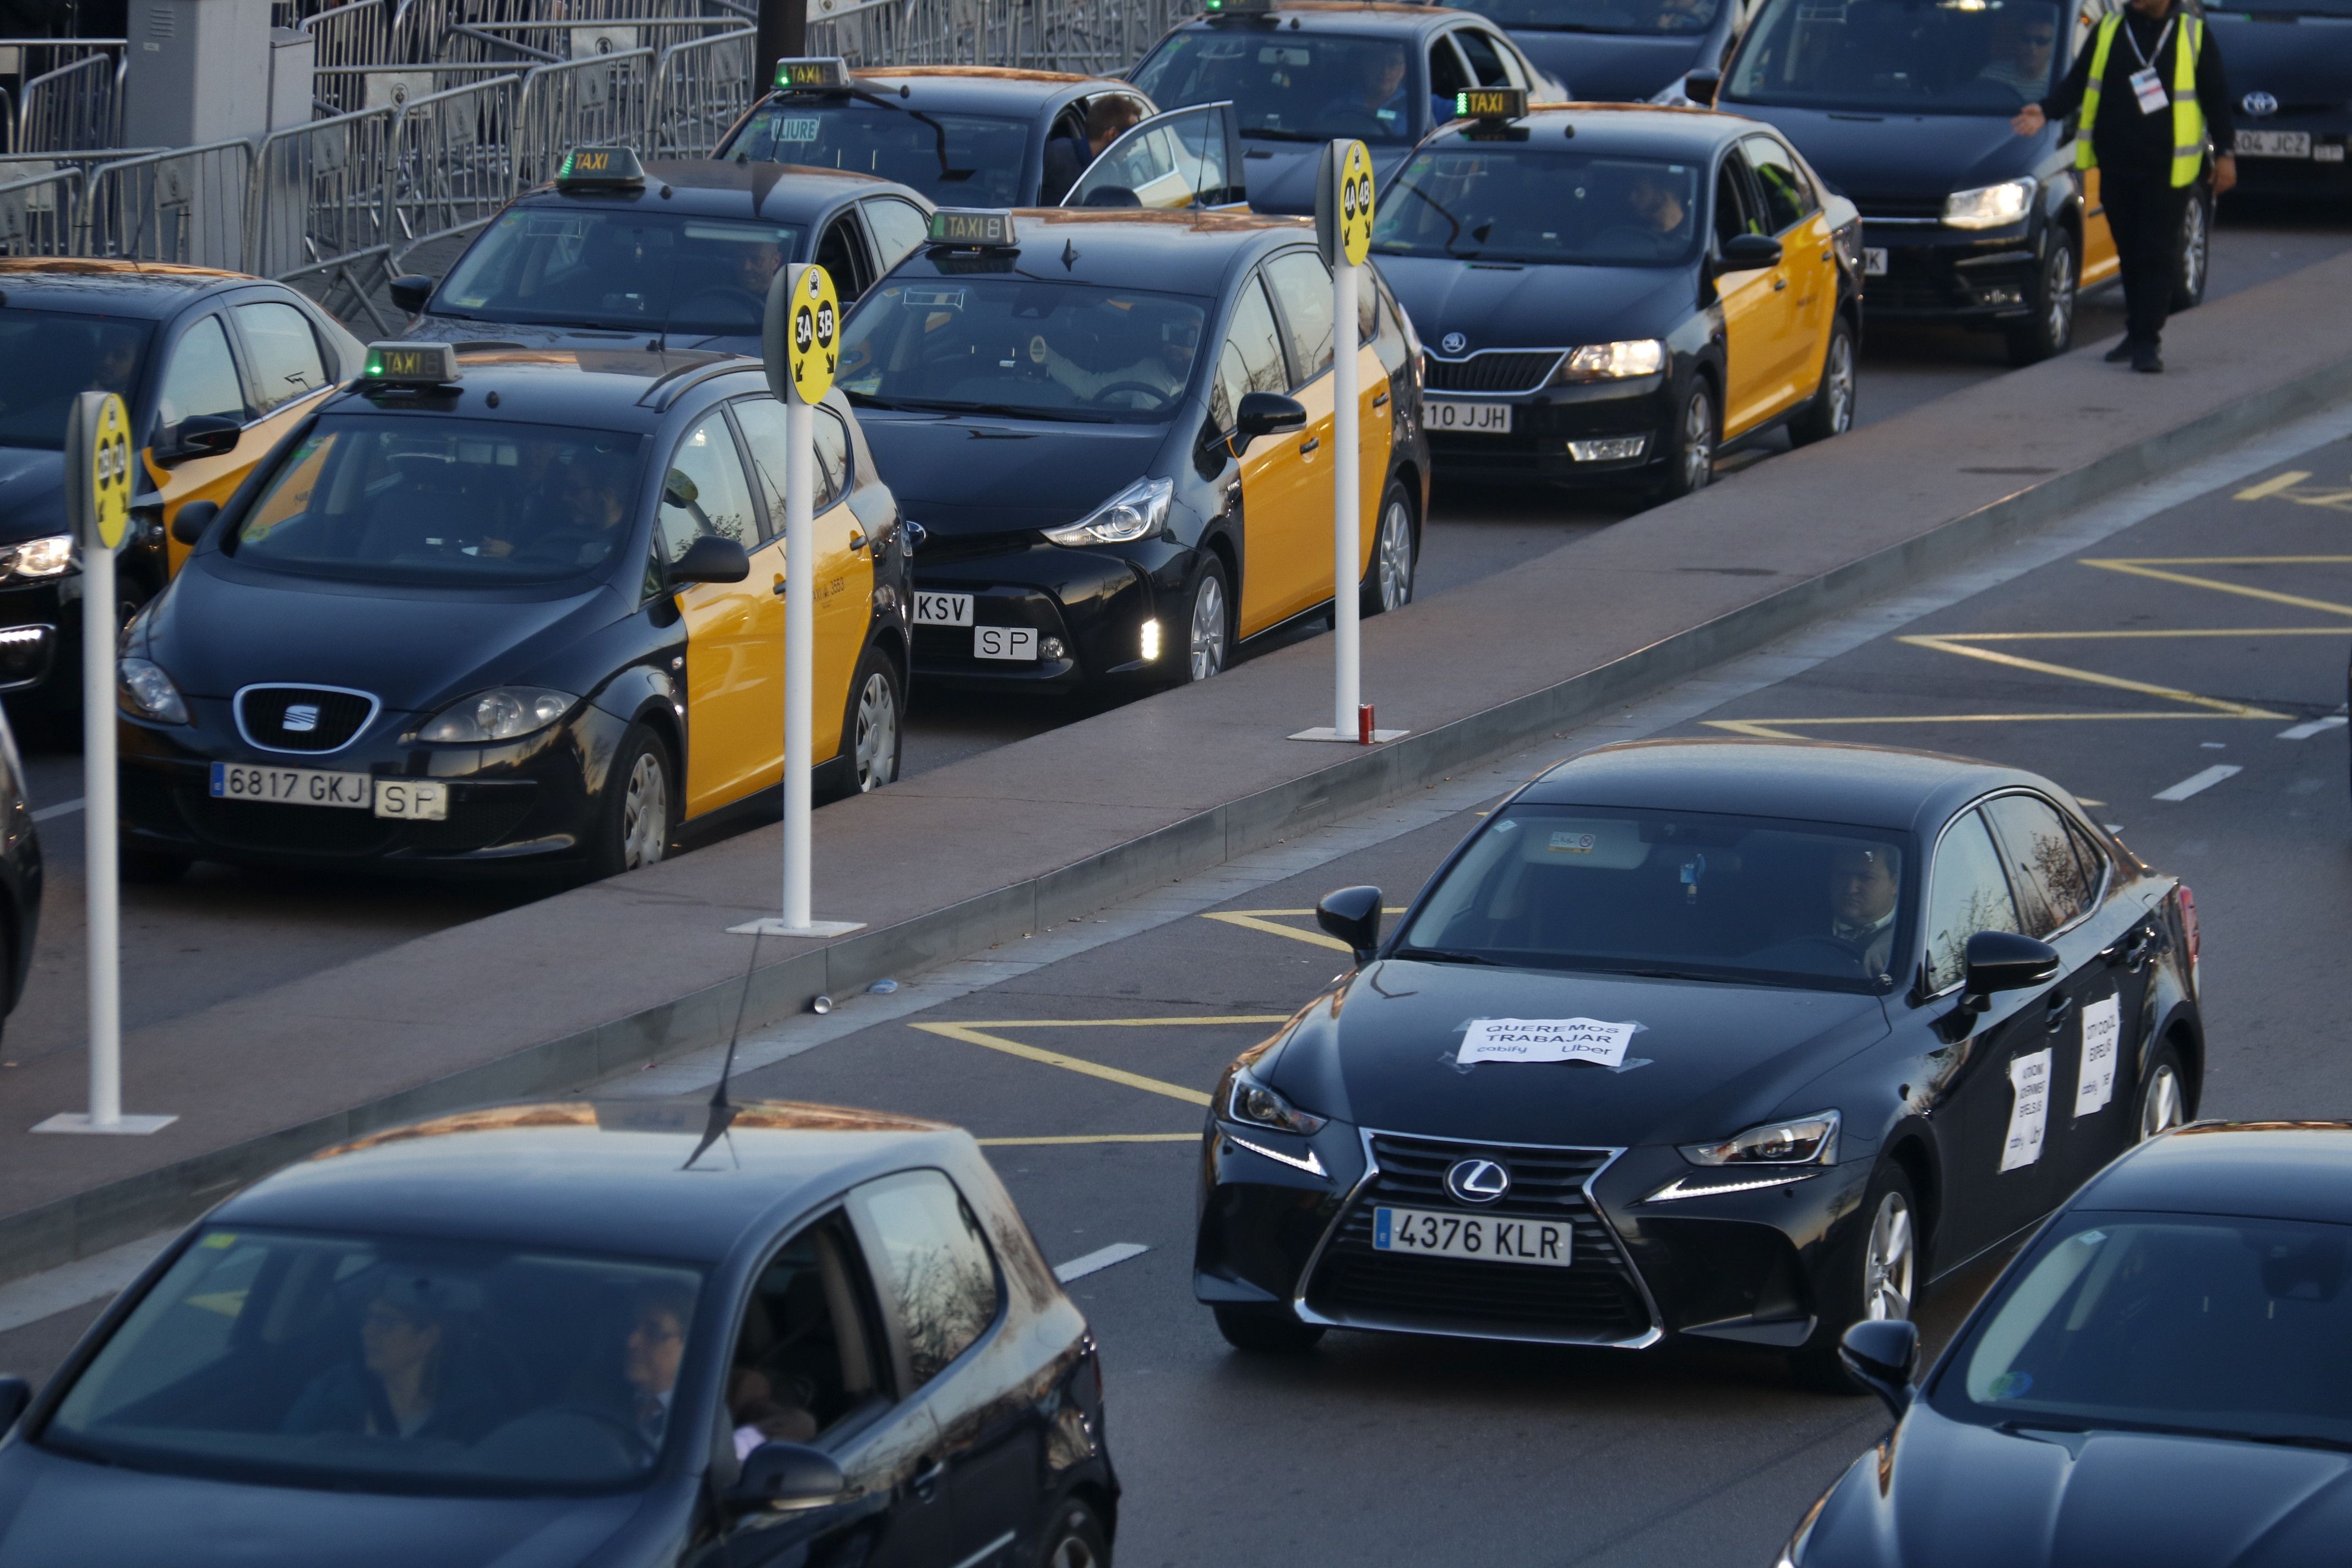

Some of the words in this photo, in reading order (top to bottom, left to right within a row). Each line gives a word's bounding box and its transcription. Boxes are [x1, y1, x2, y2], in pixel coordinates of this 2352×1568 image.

[790, 64, 821, 83] TAXI
[1468, 92, 1503, 113] TAXI
[575, 153, 608, 170] TAXI
[1344, 185, 1355, 212] 4A
[1359, 180, 1369, 206] 4B
[948, 215, 983, 238] TAXI
[796, 314, 813, 344] 3A
[818, 309, 833, 339] 3B
[384, 351, 422, 374] TAXI
[1462, 406, 1505, 428] JJH
[918, 596, 965, 621] KSV
[982, 630, 1029, 655] SP
[230, 769, 298, 798] 6817
[309, 776, 364, 803] GKJ
[1486, 1024, 1620, 1034] QUEREMOS
[1486, 1035, 1612, 1043] TRABAJAR
[1398, 1215, 1482, 1253] 4376
[1495, 1222, 1558, 1260] KLR
